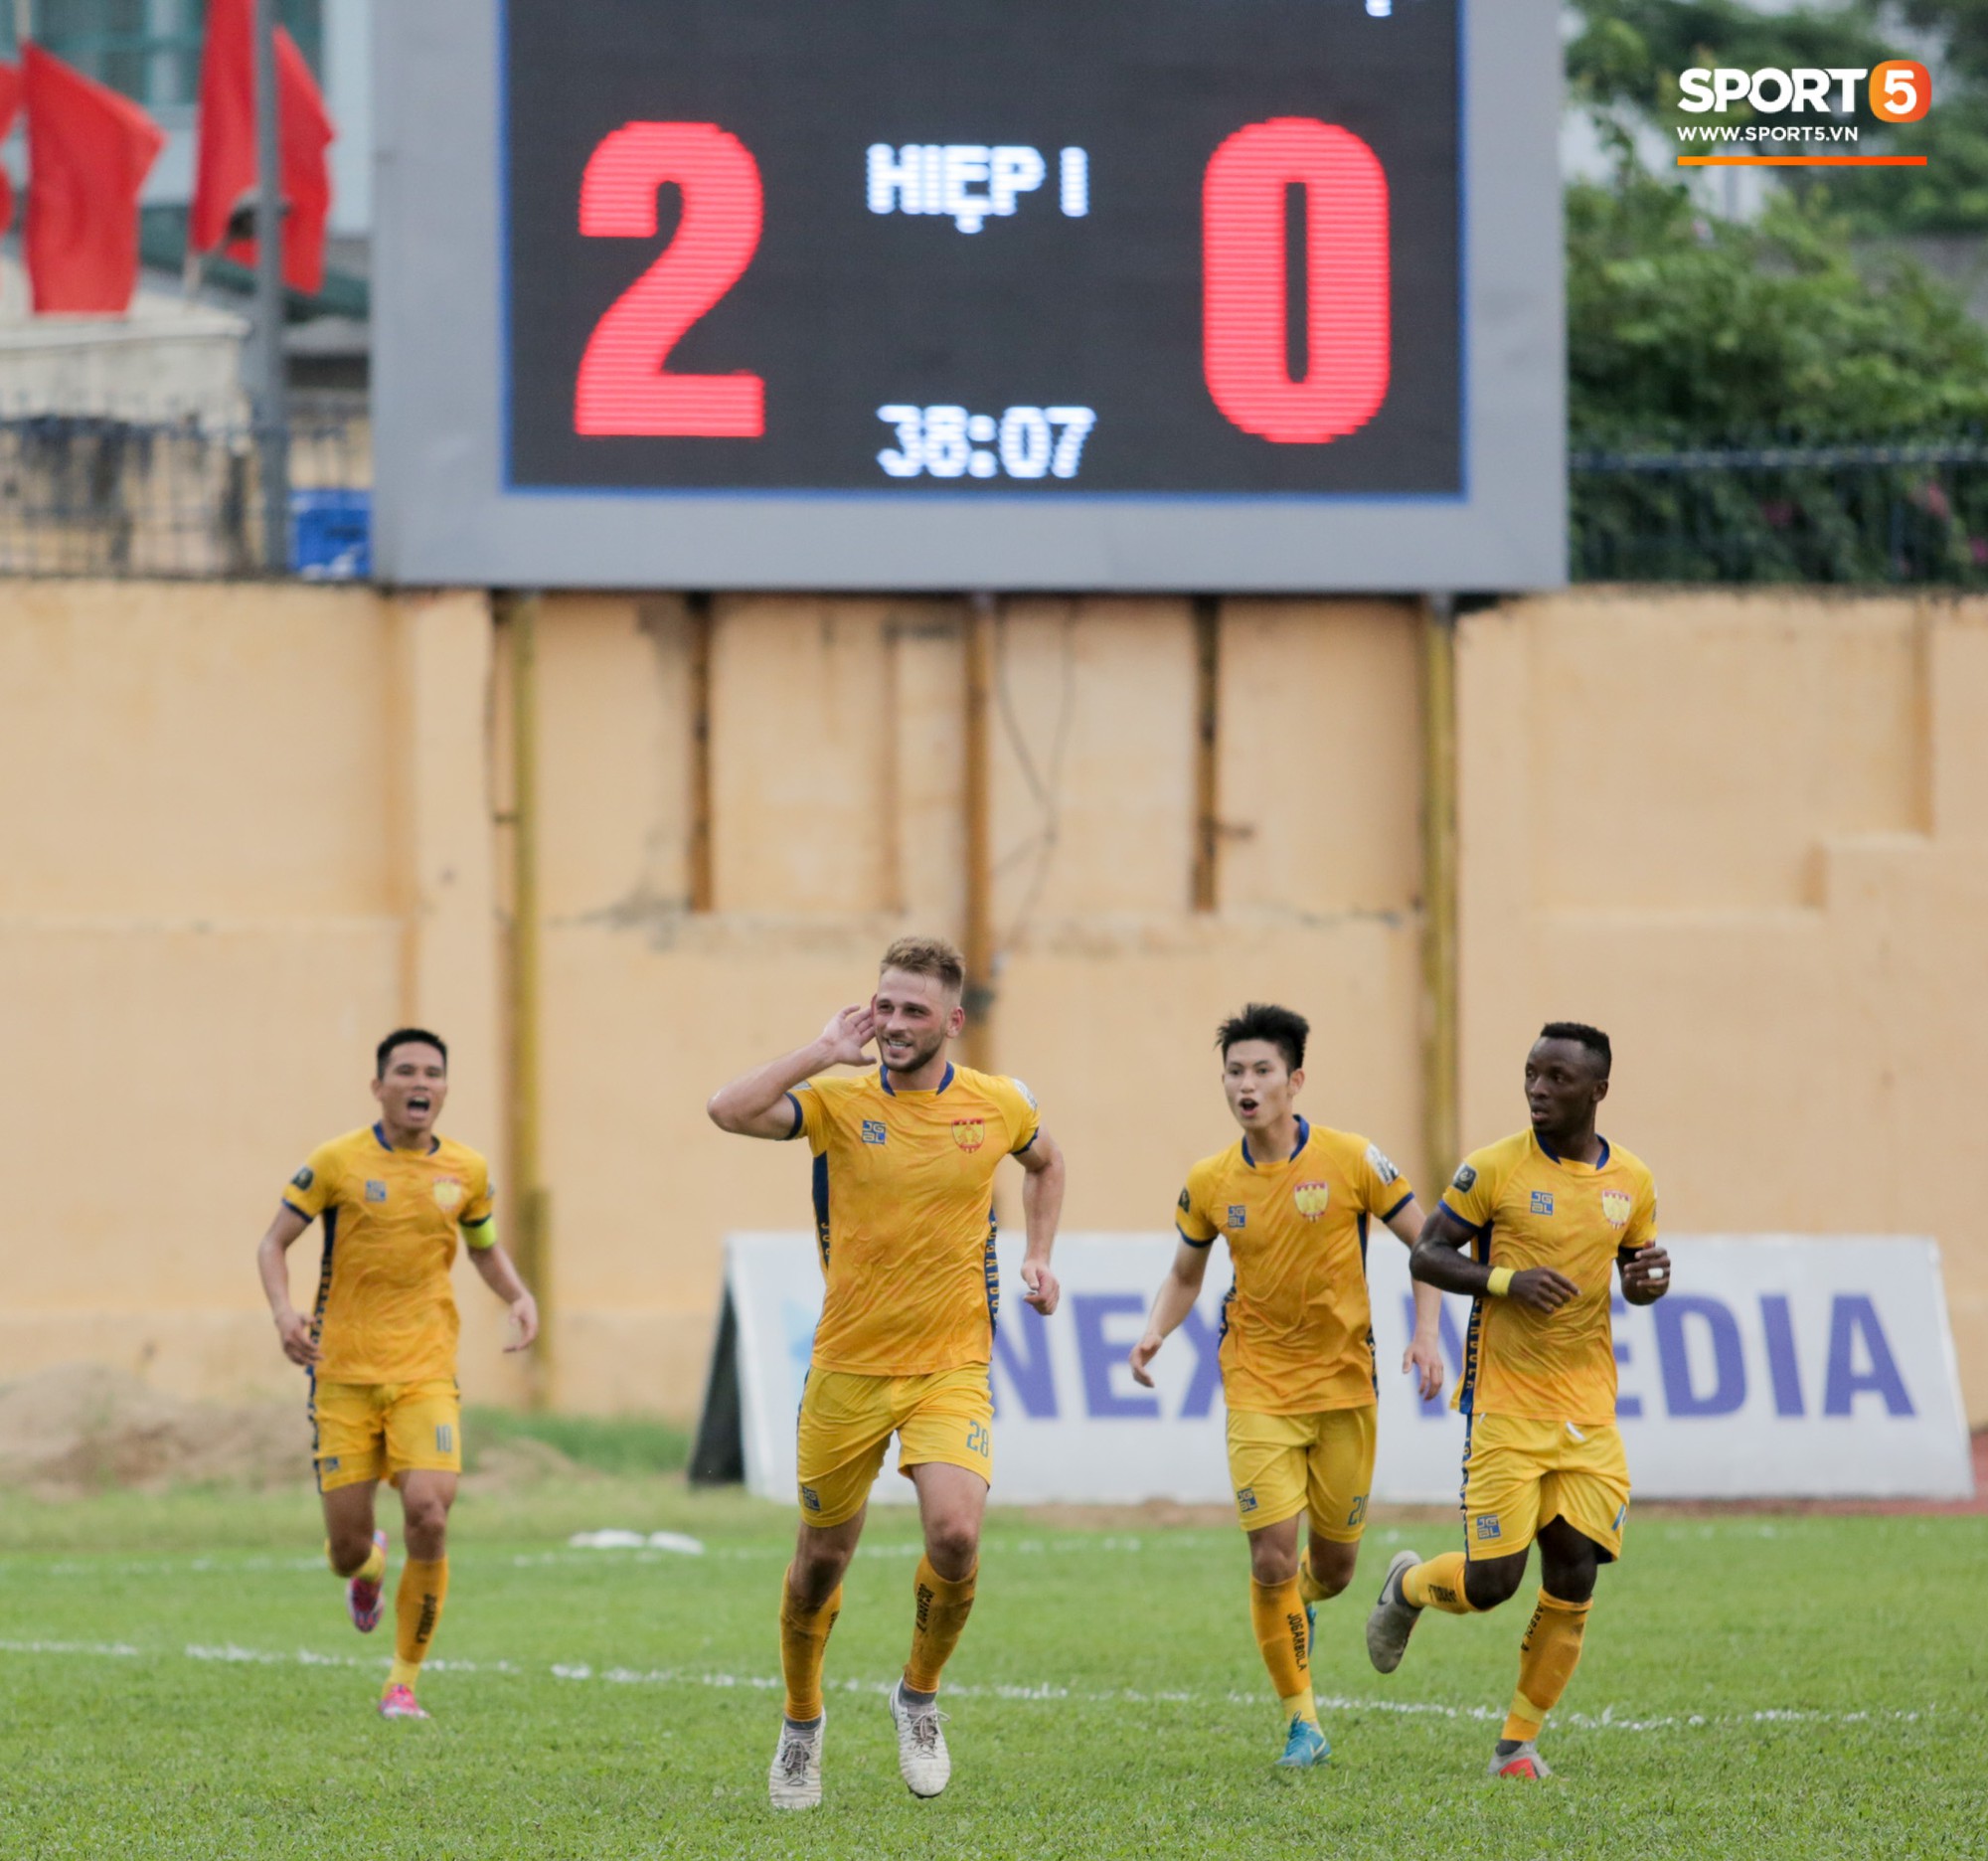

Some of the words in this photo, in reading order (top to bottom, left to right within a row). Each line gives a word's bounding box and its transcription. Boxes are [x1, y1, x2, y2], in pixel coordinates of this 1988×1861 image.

[574, 120, 765, 438] 2
[1202, 116, 1391, 444] 0
[877, 405, 1096, 478] 38:07
[966, 1420, 989, 1458] 28
